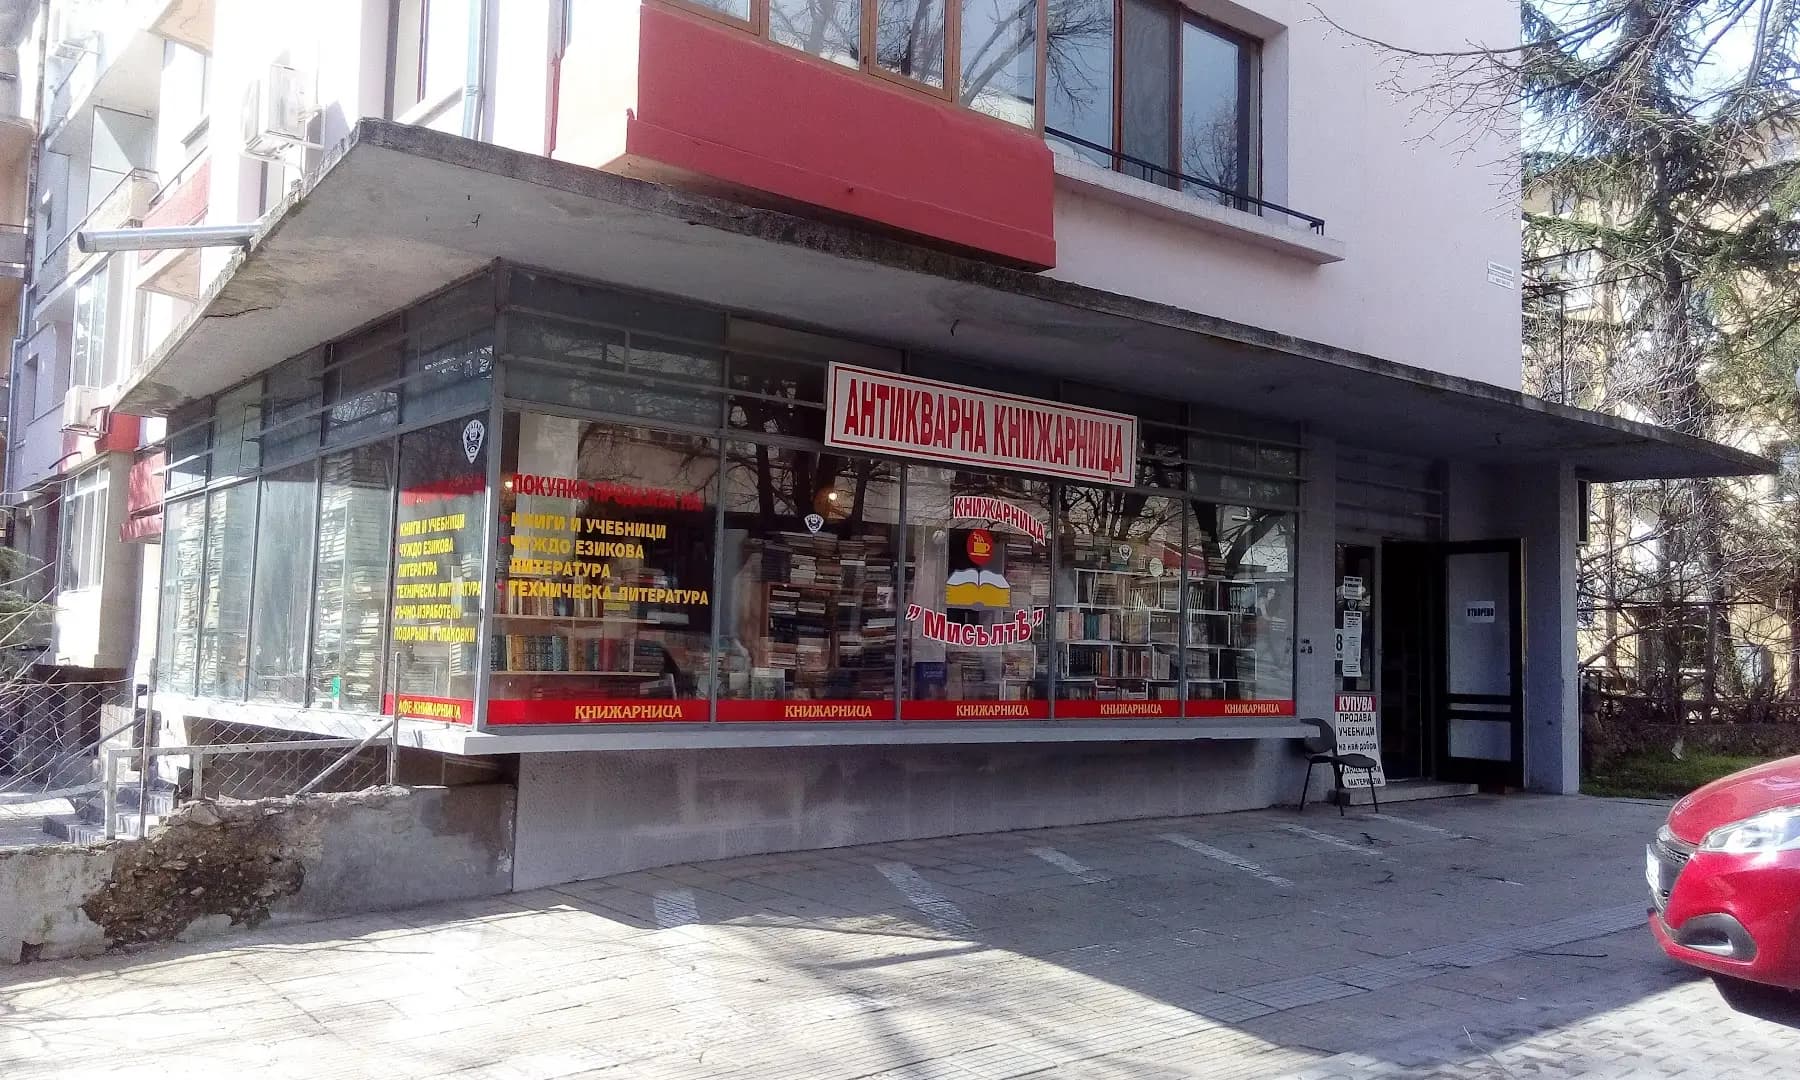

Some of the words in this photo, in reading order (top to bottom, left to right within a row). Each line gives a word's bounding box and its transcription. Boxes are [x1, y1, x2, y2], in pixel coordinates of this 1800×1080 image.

[843, 378, 987, 454] АНТИКВАРНА
[993, 403, 1123, 482] КНИЖАРНИЦА
[428, 513, 465, 532] УЧЕБНИЦИ
[570, 516, 582, 533] И
[586, 518, 667, 541] УЧЕБНИЦИ
[953, 495, 1046, 546] КНИЖАРНИЦА
[399, 541, 422, 558] ЧУЖДО
[423, 537, 454, 555] ЕЗИКОВА
[575, 539, 645, 560] ЕЗИКОВА
[397, 561, 438, 578] ЛИТЕРАТУРА
[509, 557, 611, 579] ЛИТЕРАТУРА
[396, 583, 437, 599] ТЕХНИЧЕСКА
[508, 579, 613, 600] ТЕХНИЧЕСКА
[618, 586, 709, 606] ЛИТЕРАТУРА
[436, 626, 476, 643] ОПАКОВКИ
[956, 704, 1030, 717] КНИЖАРНИЦА
[1100, 703, 1163, 715] КНИЖАРНИЦА
[1224, 703, 1280, 714] КНИЖАРНИЦА
[1339, 695, 1373, 711] КУПУВА
[574, 704, 683, 720] КНИЖАРНИЦА
[785, 705, 872, 718] КНИЖАРНИЦА
[1340, 713, 1372, 722] ПРОДАВА
[1338, 727, 1375, 737] УЧЕБНИЦИ
[1348, 778, 1381, 786] МАТЕРИЛИ
